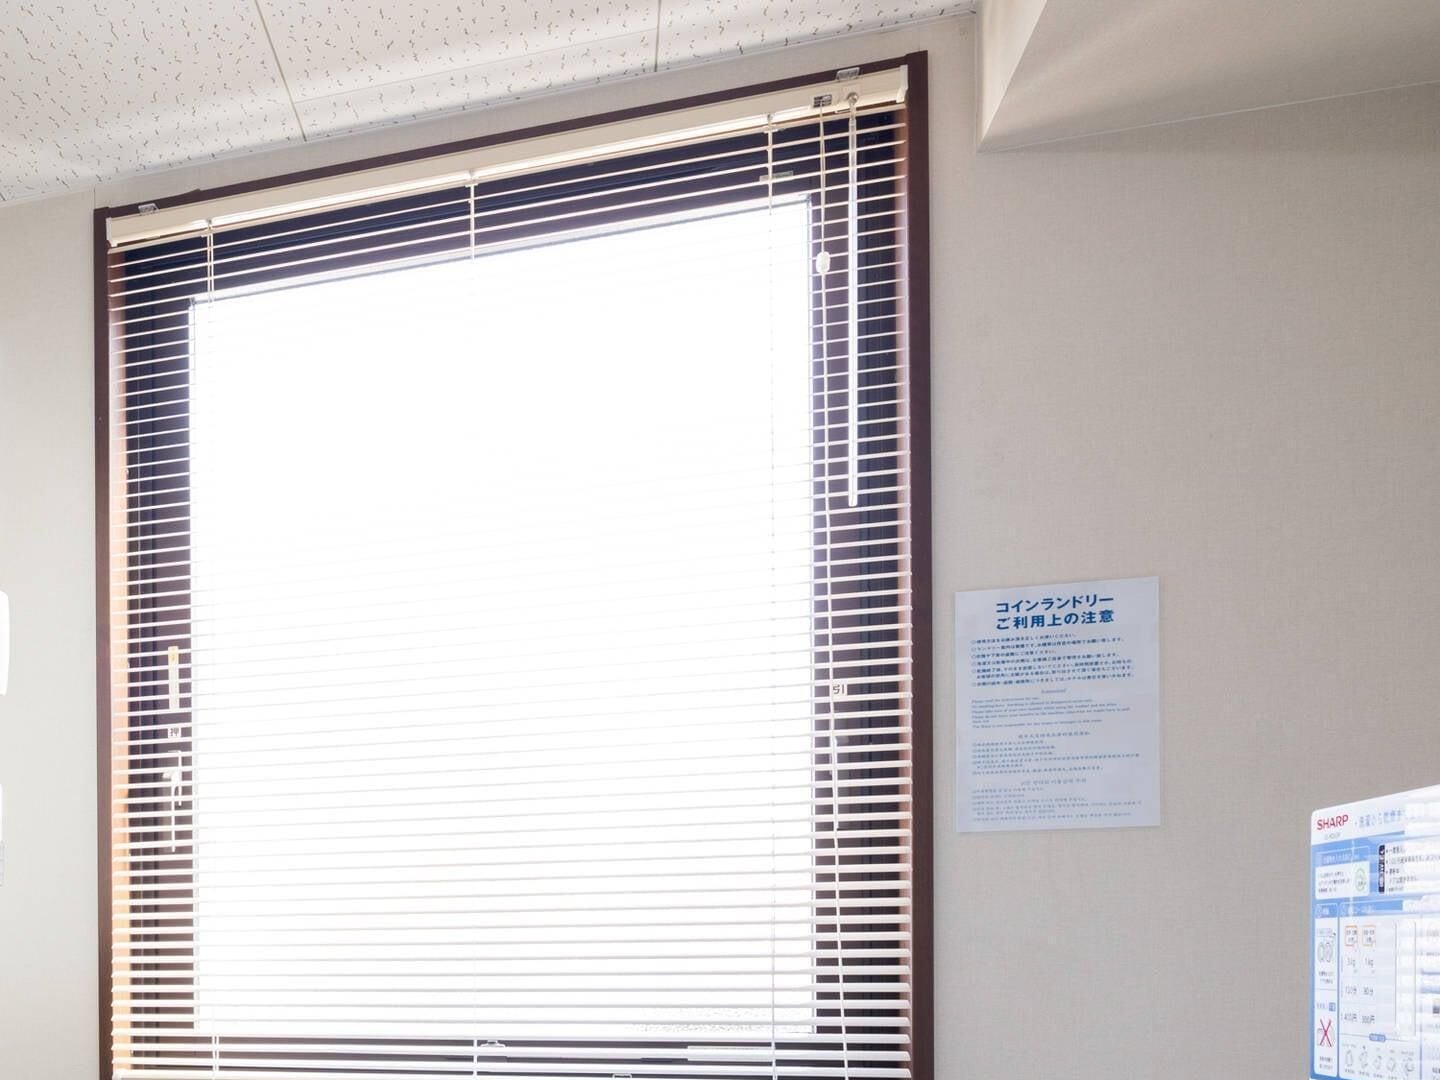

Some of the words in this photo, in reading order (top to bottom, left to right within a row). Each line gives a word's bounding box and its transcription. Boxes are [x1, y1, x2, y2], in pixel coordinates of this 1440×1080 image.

[995, 594, 1114, 614] コインランドリー
[996, 609, 1114, 630] ご利用上の注意
[1316, 814, 1349, 831] SHARP
